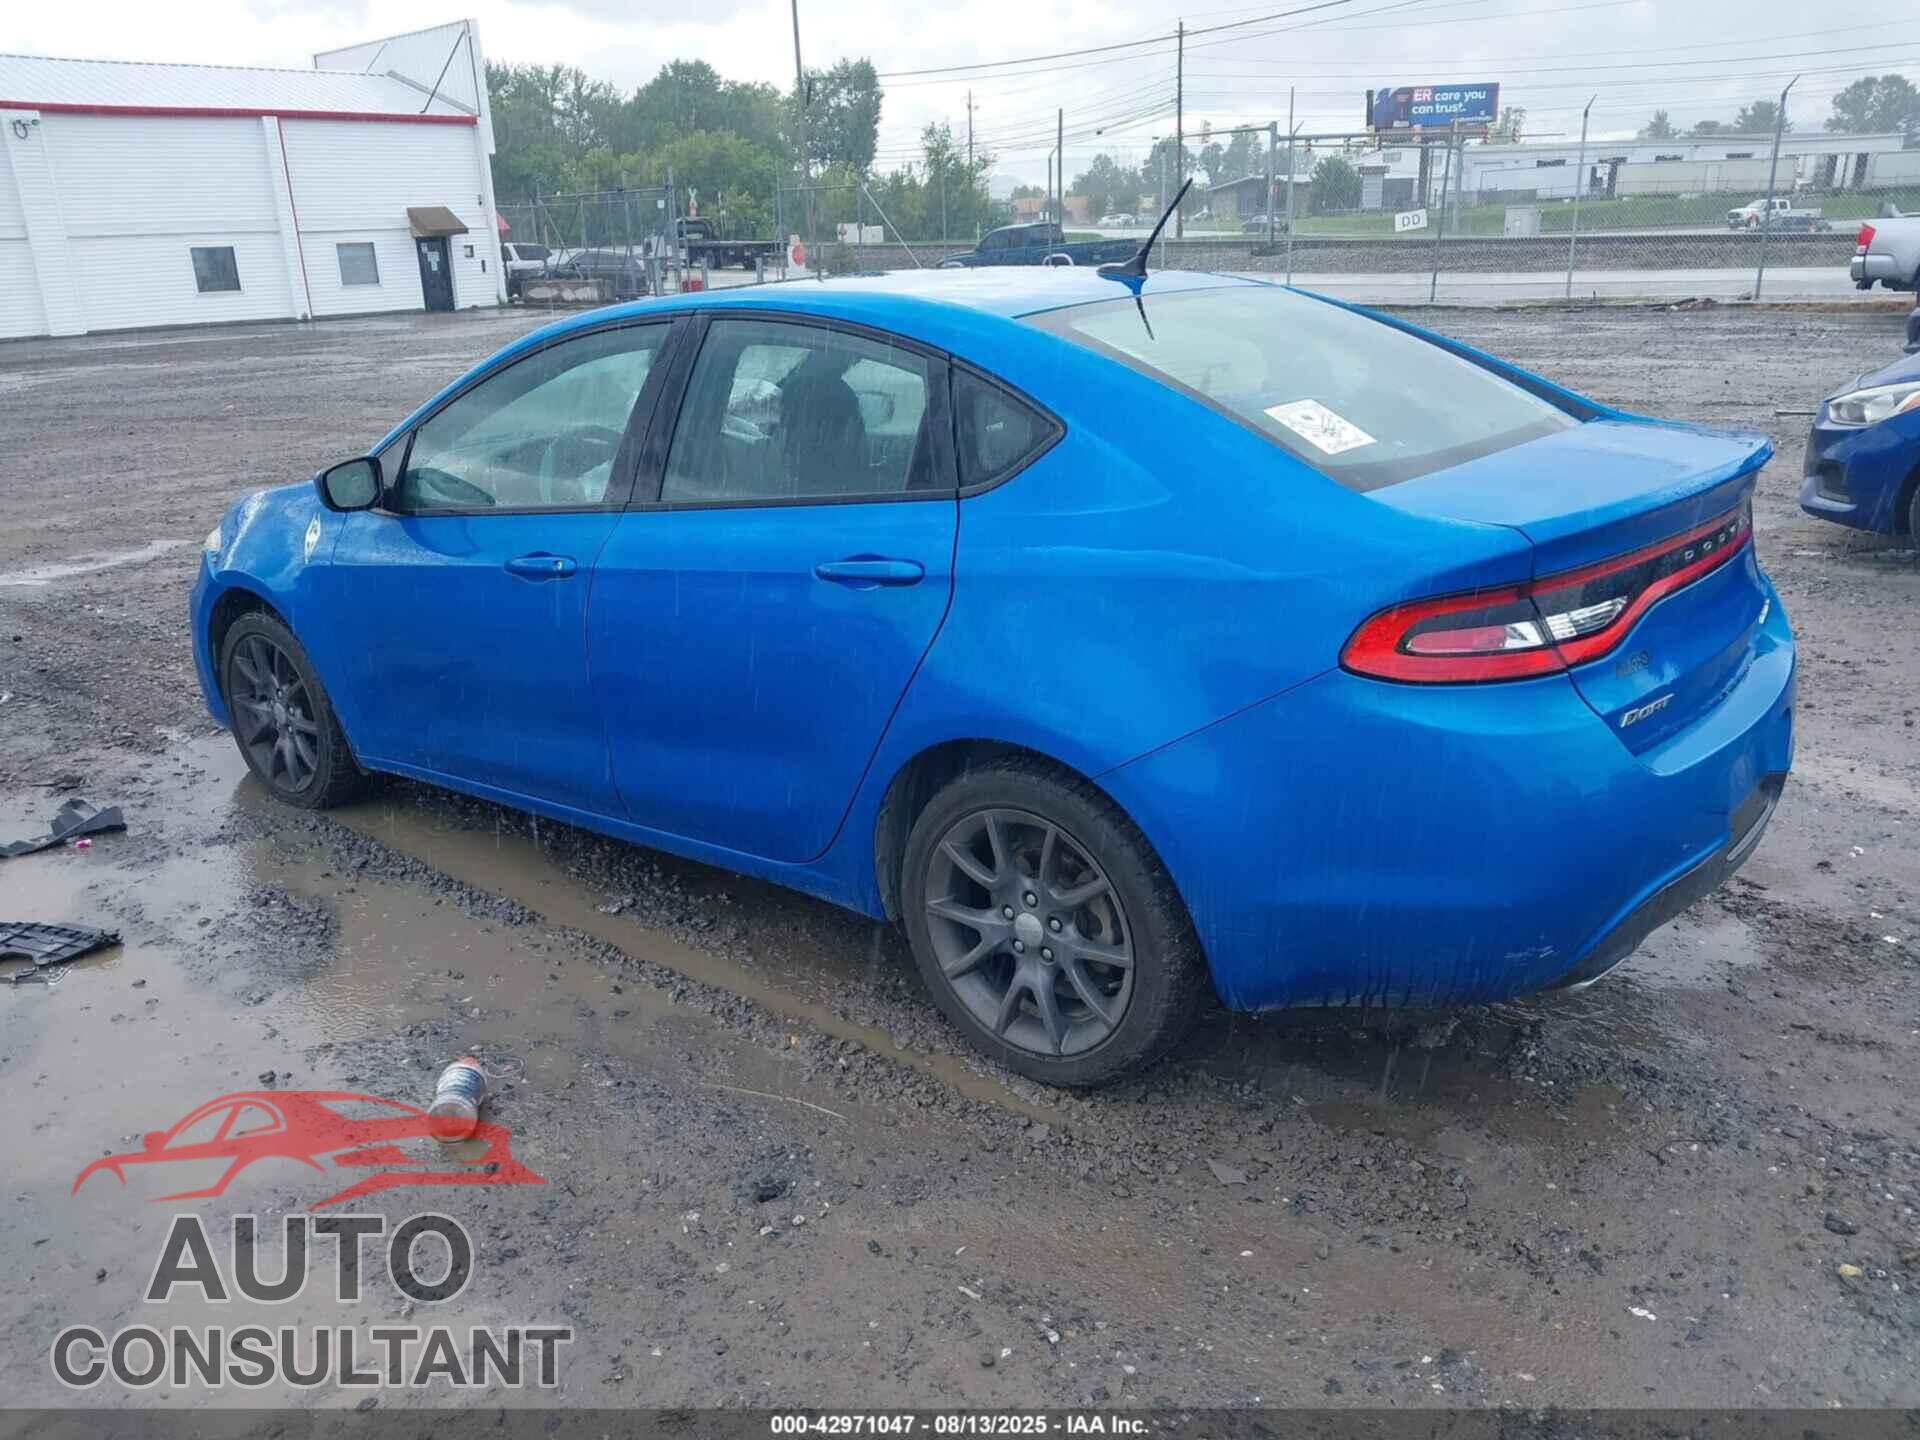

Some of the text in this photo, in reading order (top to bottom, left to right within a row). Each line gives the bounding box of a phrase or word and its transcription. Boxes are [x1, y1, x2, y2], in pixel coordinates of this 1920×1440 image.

[1412, 88, 1487, 104] ER care you
[1411, 102, 1466, 115] can trust.
